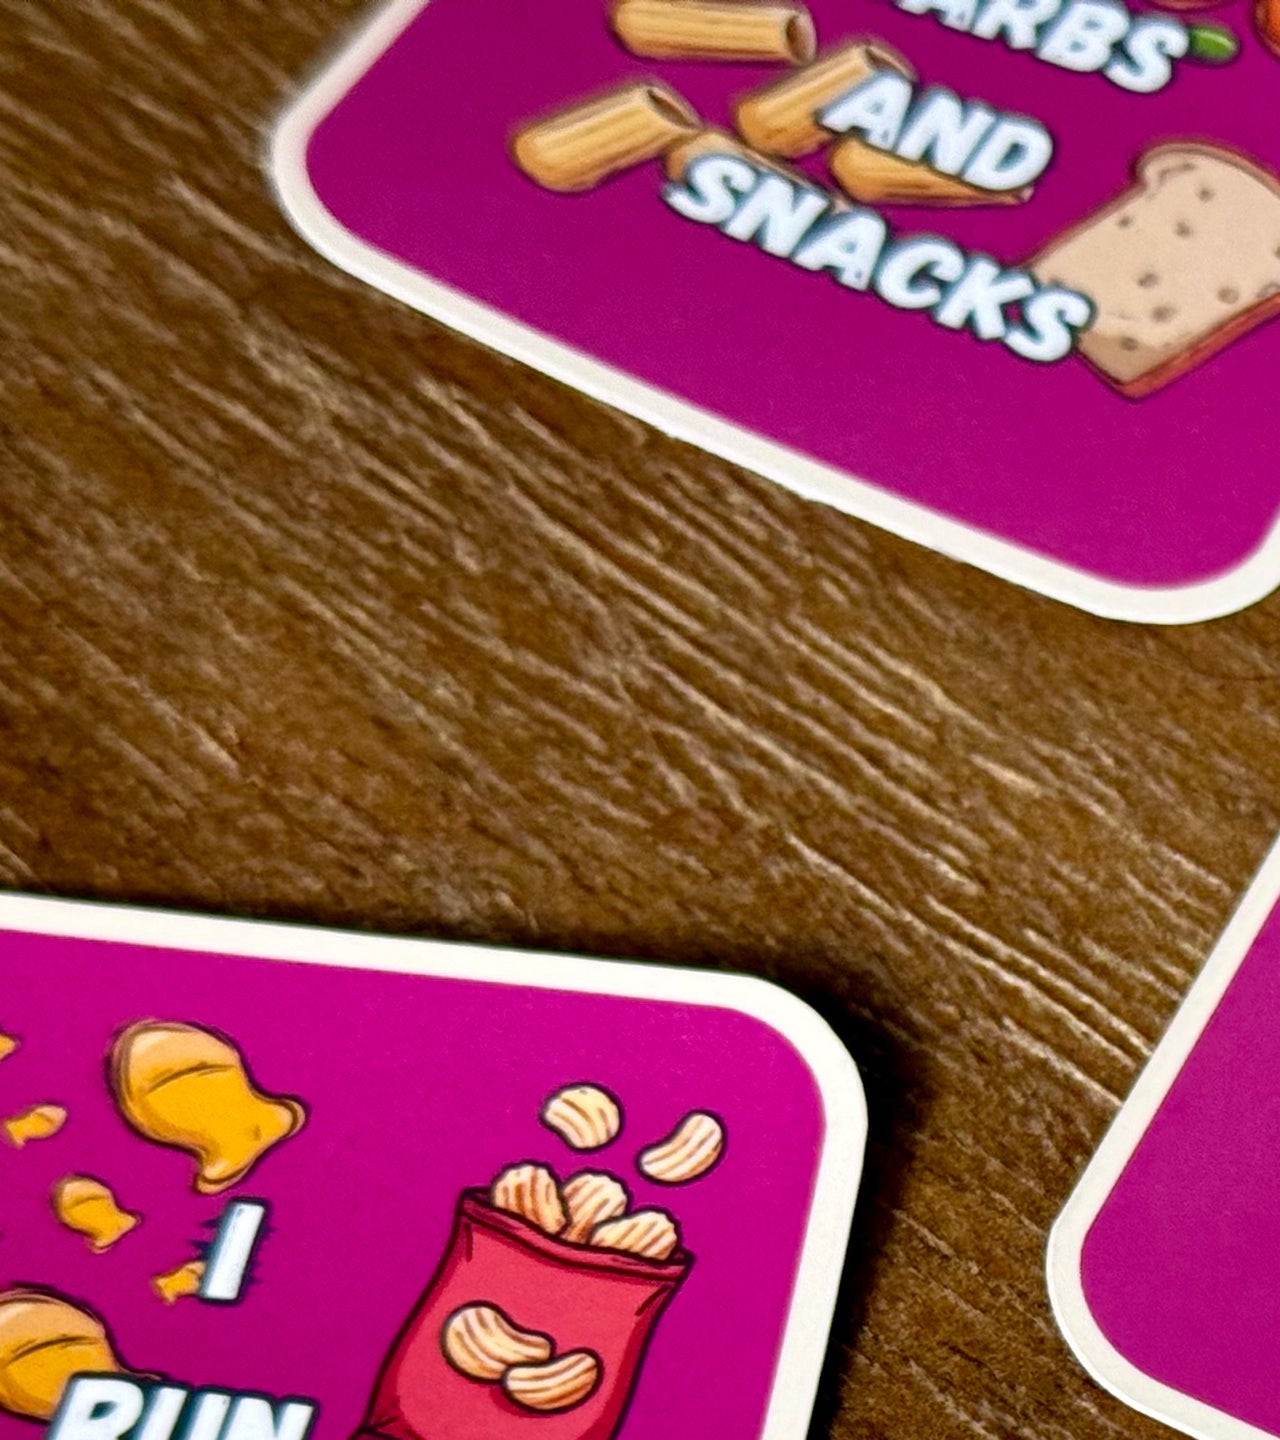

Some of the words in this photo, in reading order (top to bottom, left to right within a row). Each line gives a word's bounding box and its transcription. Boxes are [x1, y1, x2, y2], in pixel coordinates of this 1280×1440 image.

[823, 73, 1052, 187] AND
[668, 156, 1089, 360] SNACKS
[205, 1204, 263, 1298] I
